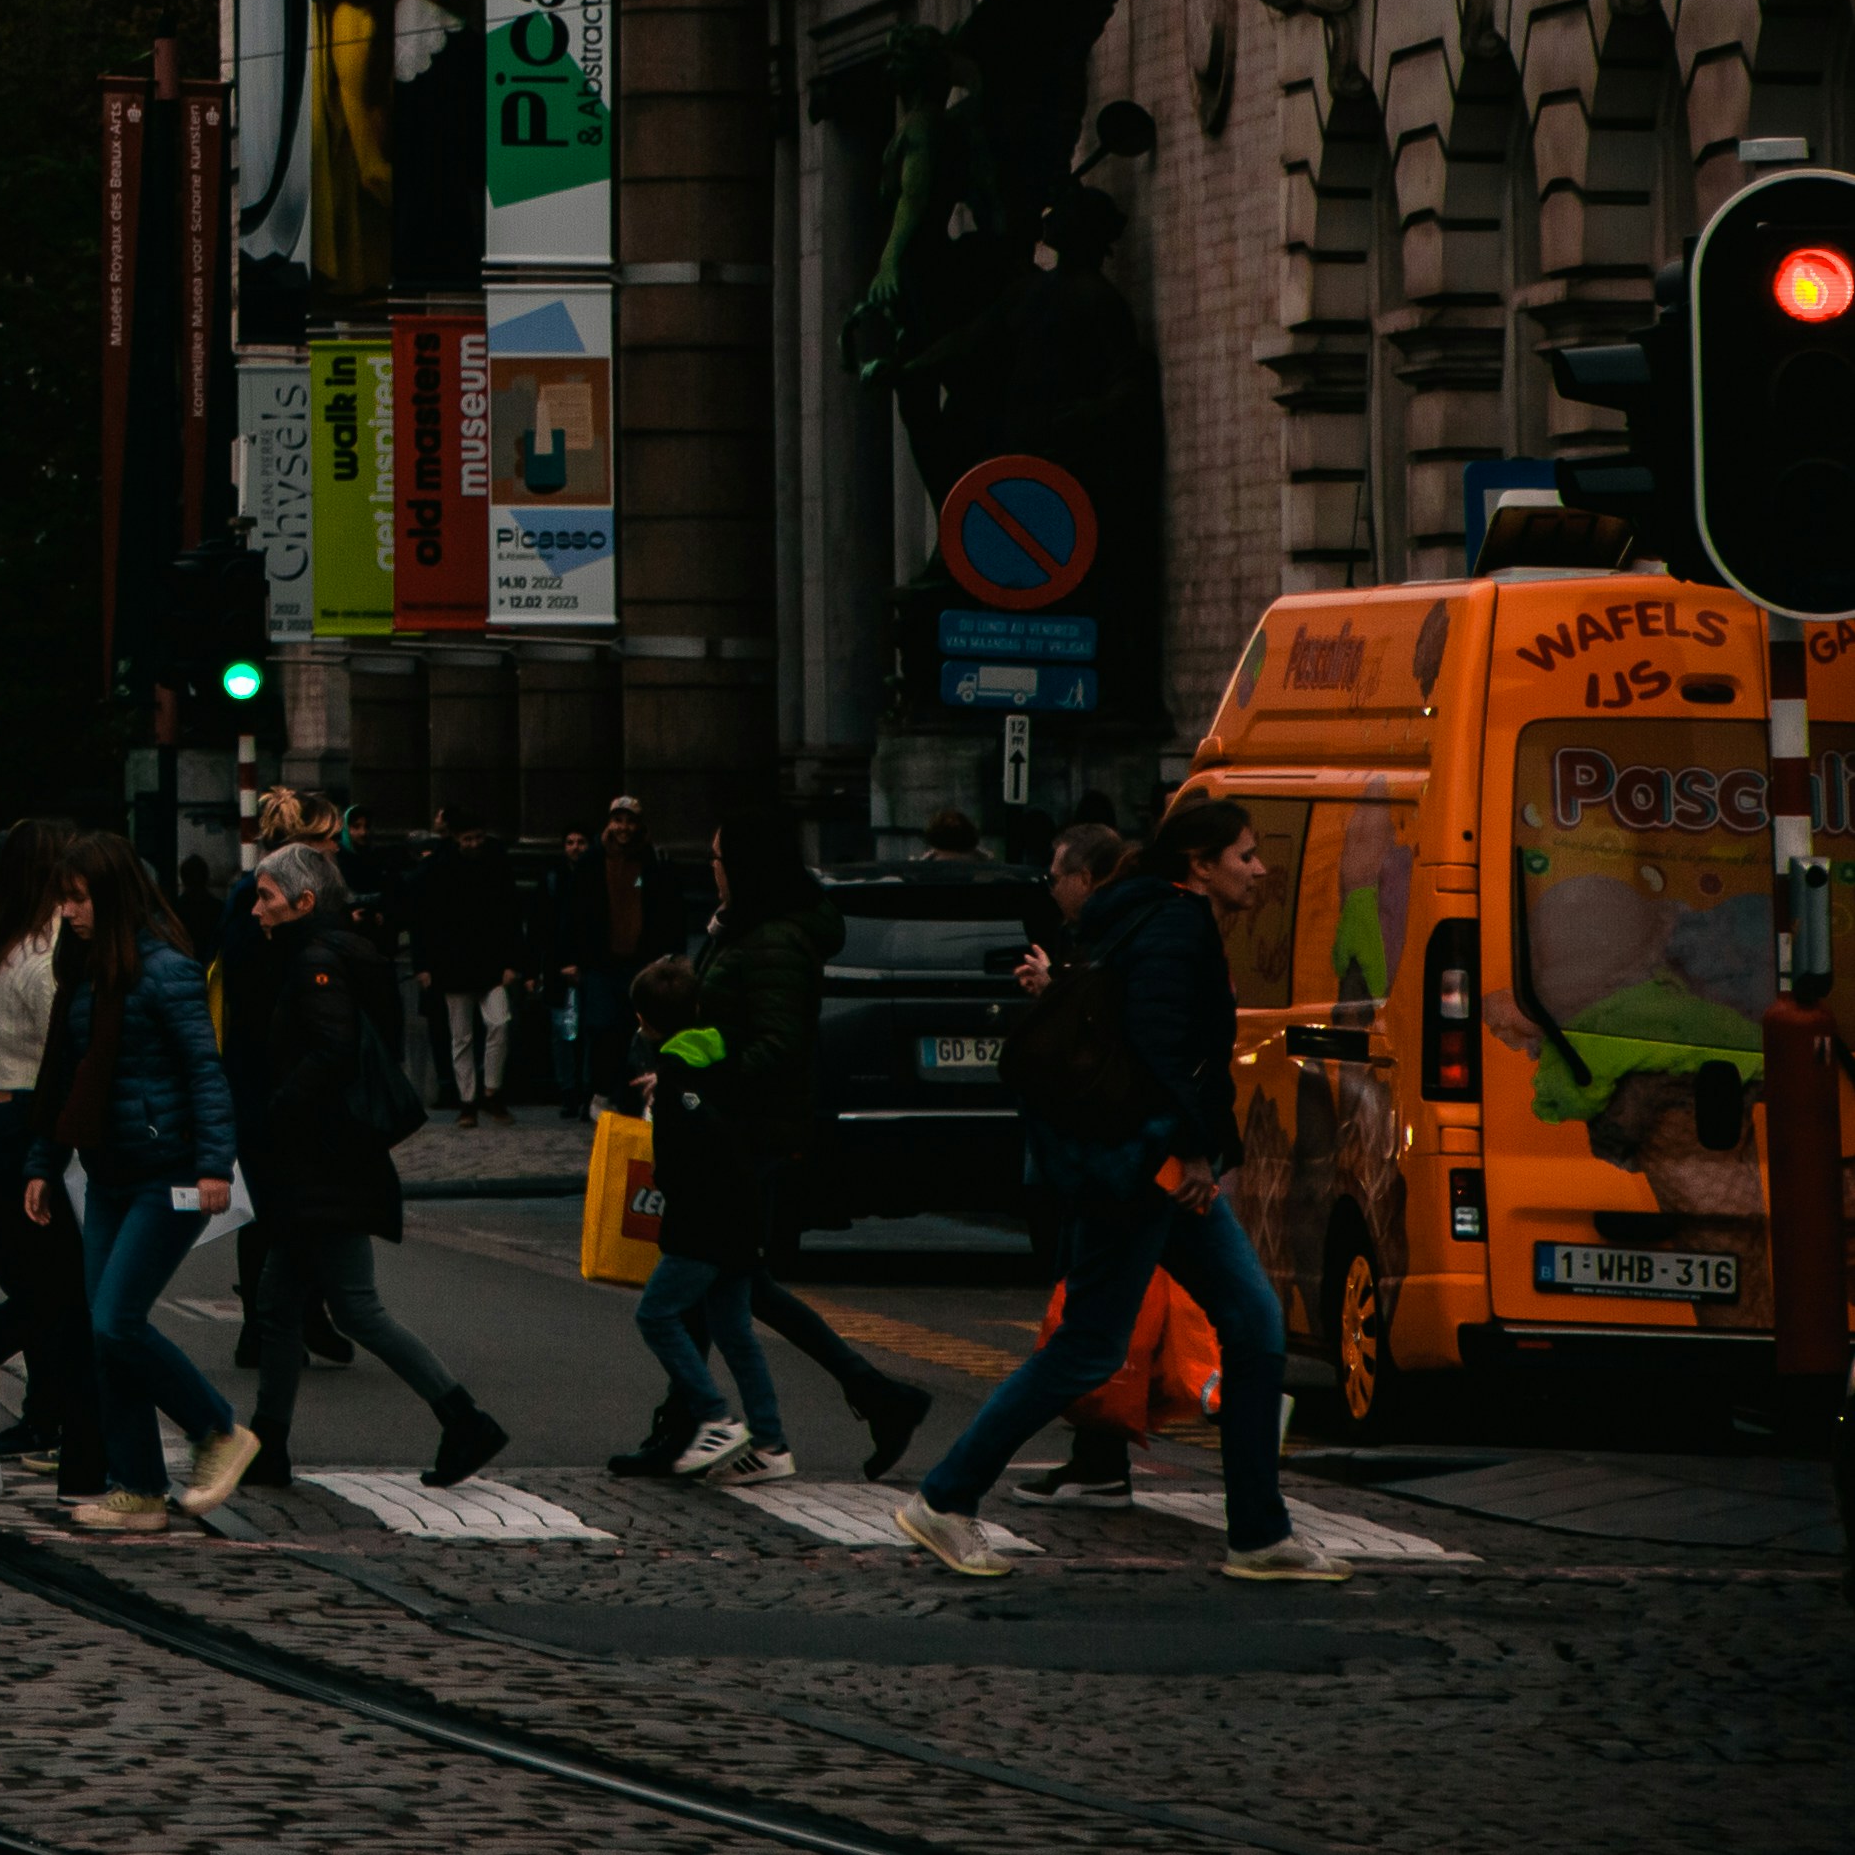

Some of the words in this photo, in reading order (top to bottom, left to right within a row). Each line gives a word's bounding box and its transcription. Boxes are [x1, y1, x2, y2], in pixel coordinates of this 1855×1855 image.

[188, 105, 201, 169] Kunsten
[580, 126, 603, 146] &
[109, 193, 122, 221] des
[190, 175, 202, 231] Schone
[109, 224, 124, 282] Royaux
[191, 236, 202, 273] voor
[109, 286, 122, 346] Musées
[191, 278, 203, 327] Musea
[192, 332, 206, 417] Koninklijke
[324, 356, 357, 386] in
[324, 393, 358, 482] walk
[366, 355, 394, 502] inspired
[411, 333, 441, 491] masters
[458, 334, 487, 497] museum
[263, 384, 308, 581] Ghysels
[406, 500, 442, 567] old
[497, 528, 607, 550] Picasso
[497, 576, 527, 589] 14.10
[531, 576, 563, 589] 2022
[510, 596, 542, 609] 12.02
[547, 596, 579, 609] 2023
[1516, 601, 1729, 672] WAFELS
[1585, 659, 1673, 710] IJS
[1011, 720, 1026, 734] 12
[1552, 746, 1855, 835] Pascl
[938, 1039, 1002, 1062] GD-62
[1561, 1251, 1732, 1289] 1-WHB-316
